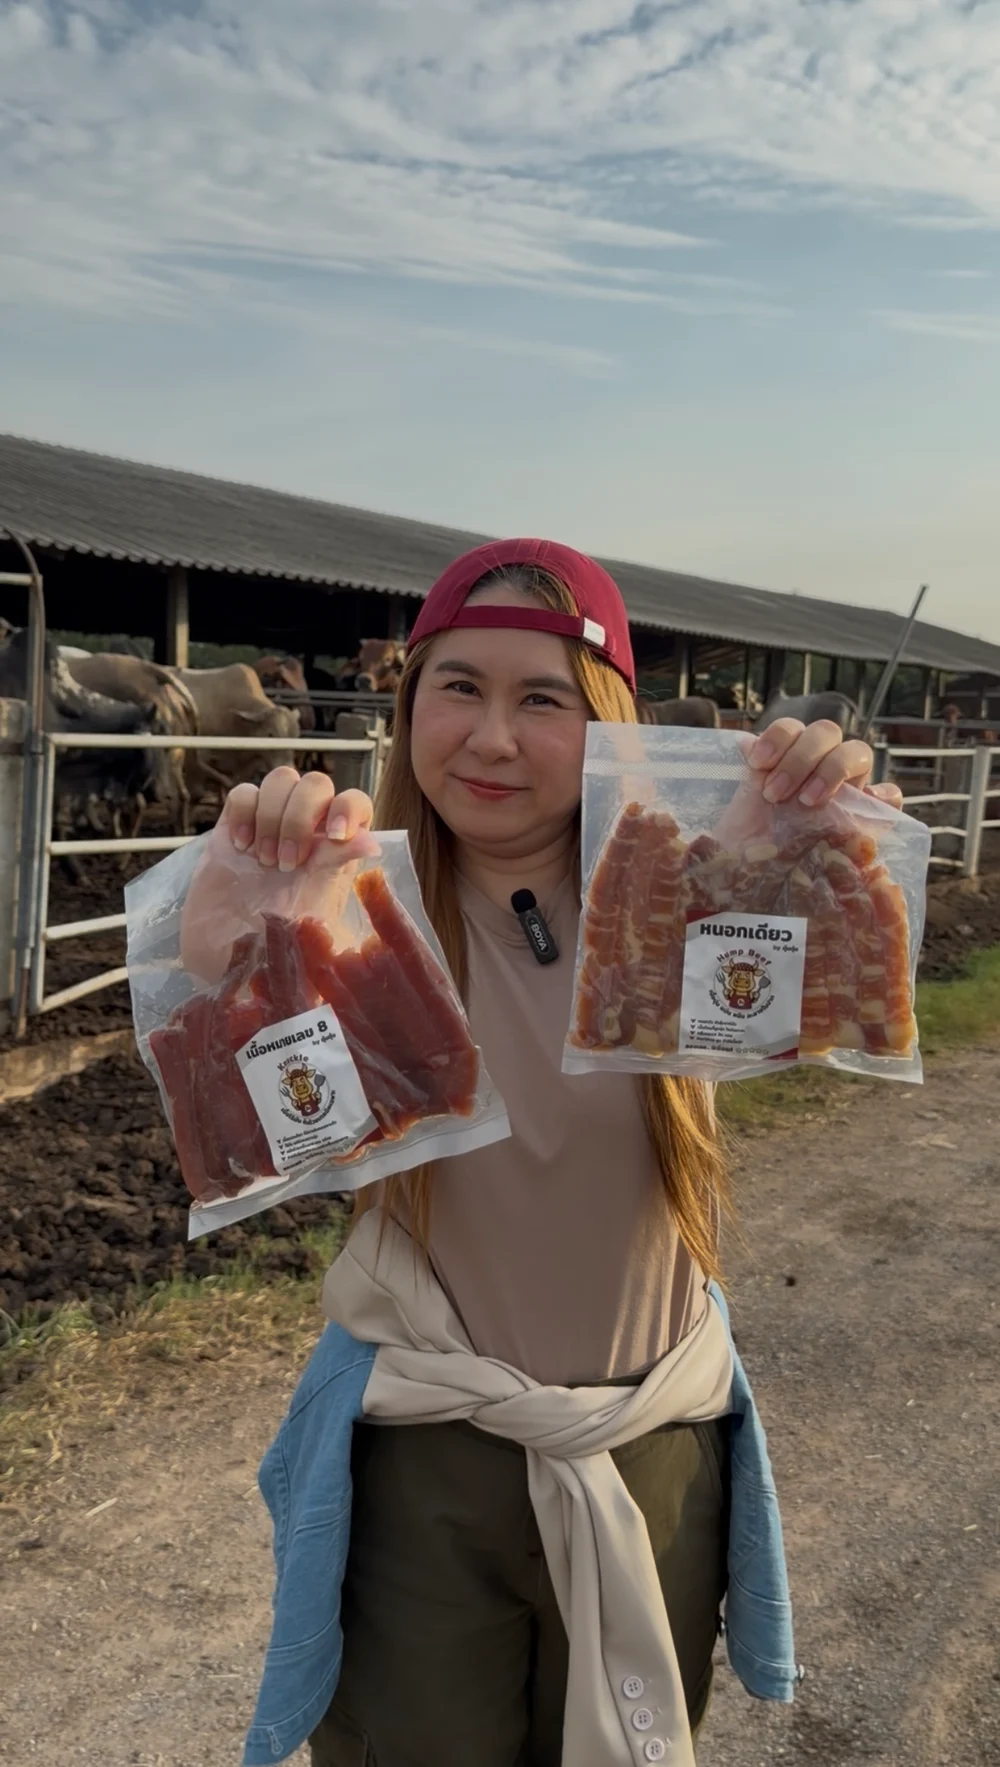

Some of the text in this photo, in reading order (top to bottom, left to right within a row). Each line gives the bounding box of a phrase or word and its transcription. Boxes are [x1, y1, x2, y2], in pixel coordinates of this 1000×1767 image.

[531, 924, 547, 951] BOYA
[700, 923, 793, 942] หนอกเดียว
[716, 949, 772, 966] Hump Beef
[246, 1028, 314, 1059] เนื้อหมายเลข
[317, 1021, 328, 1033] 8
[277, 1054, 309, 1071] Knuckle
